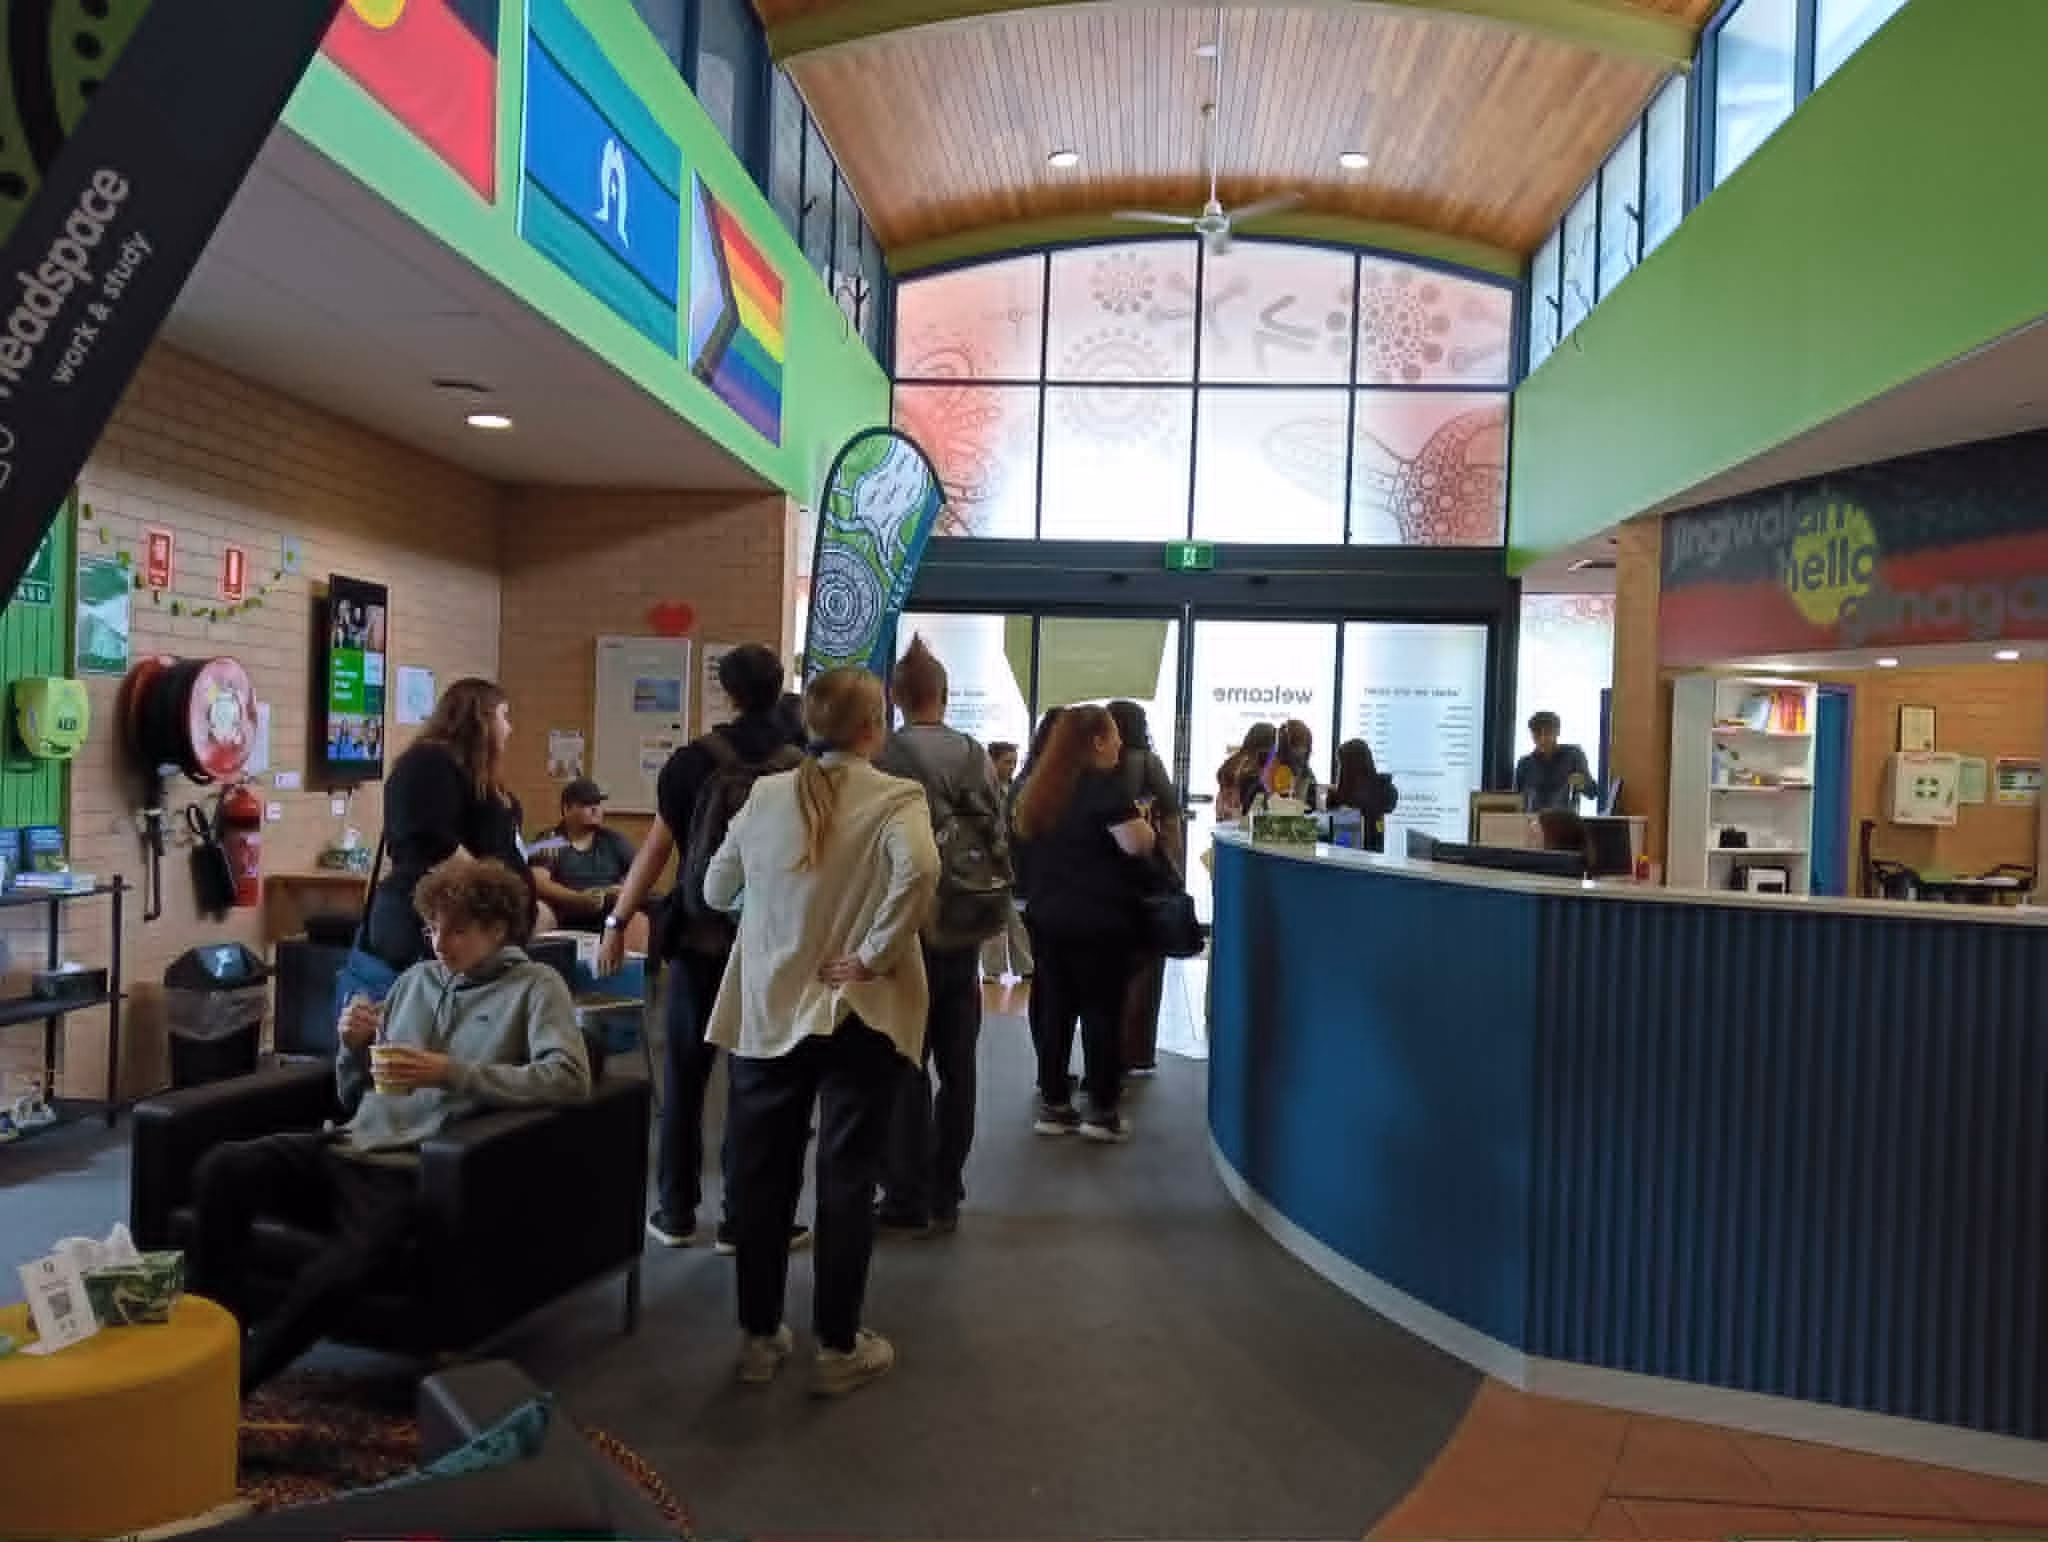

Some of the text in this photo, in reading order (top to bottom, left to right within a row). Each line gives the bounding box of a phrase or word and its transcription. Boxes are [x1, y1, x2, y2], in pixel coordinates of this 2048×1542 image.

[53, 321, 99, 383] work
[103, 231, 152, 300] study
[1781, 537, 1876, 592] hello
